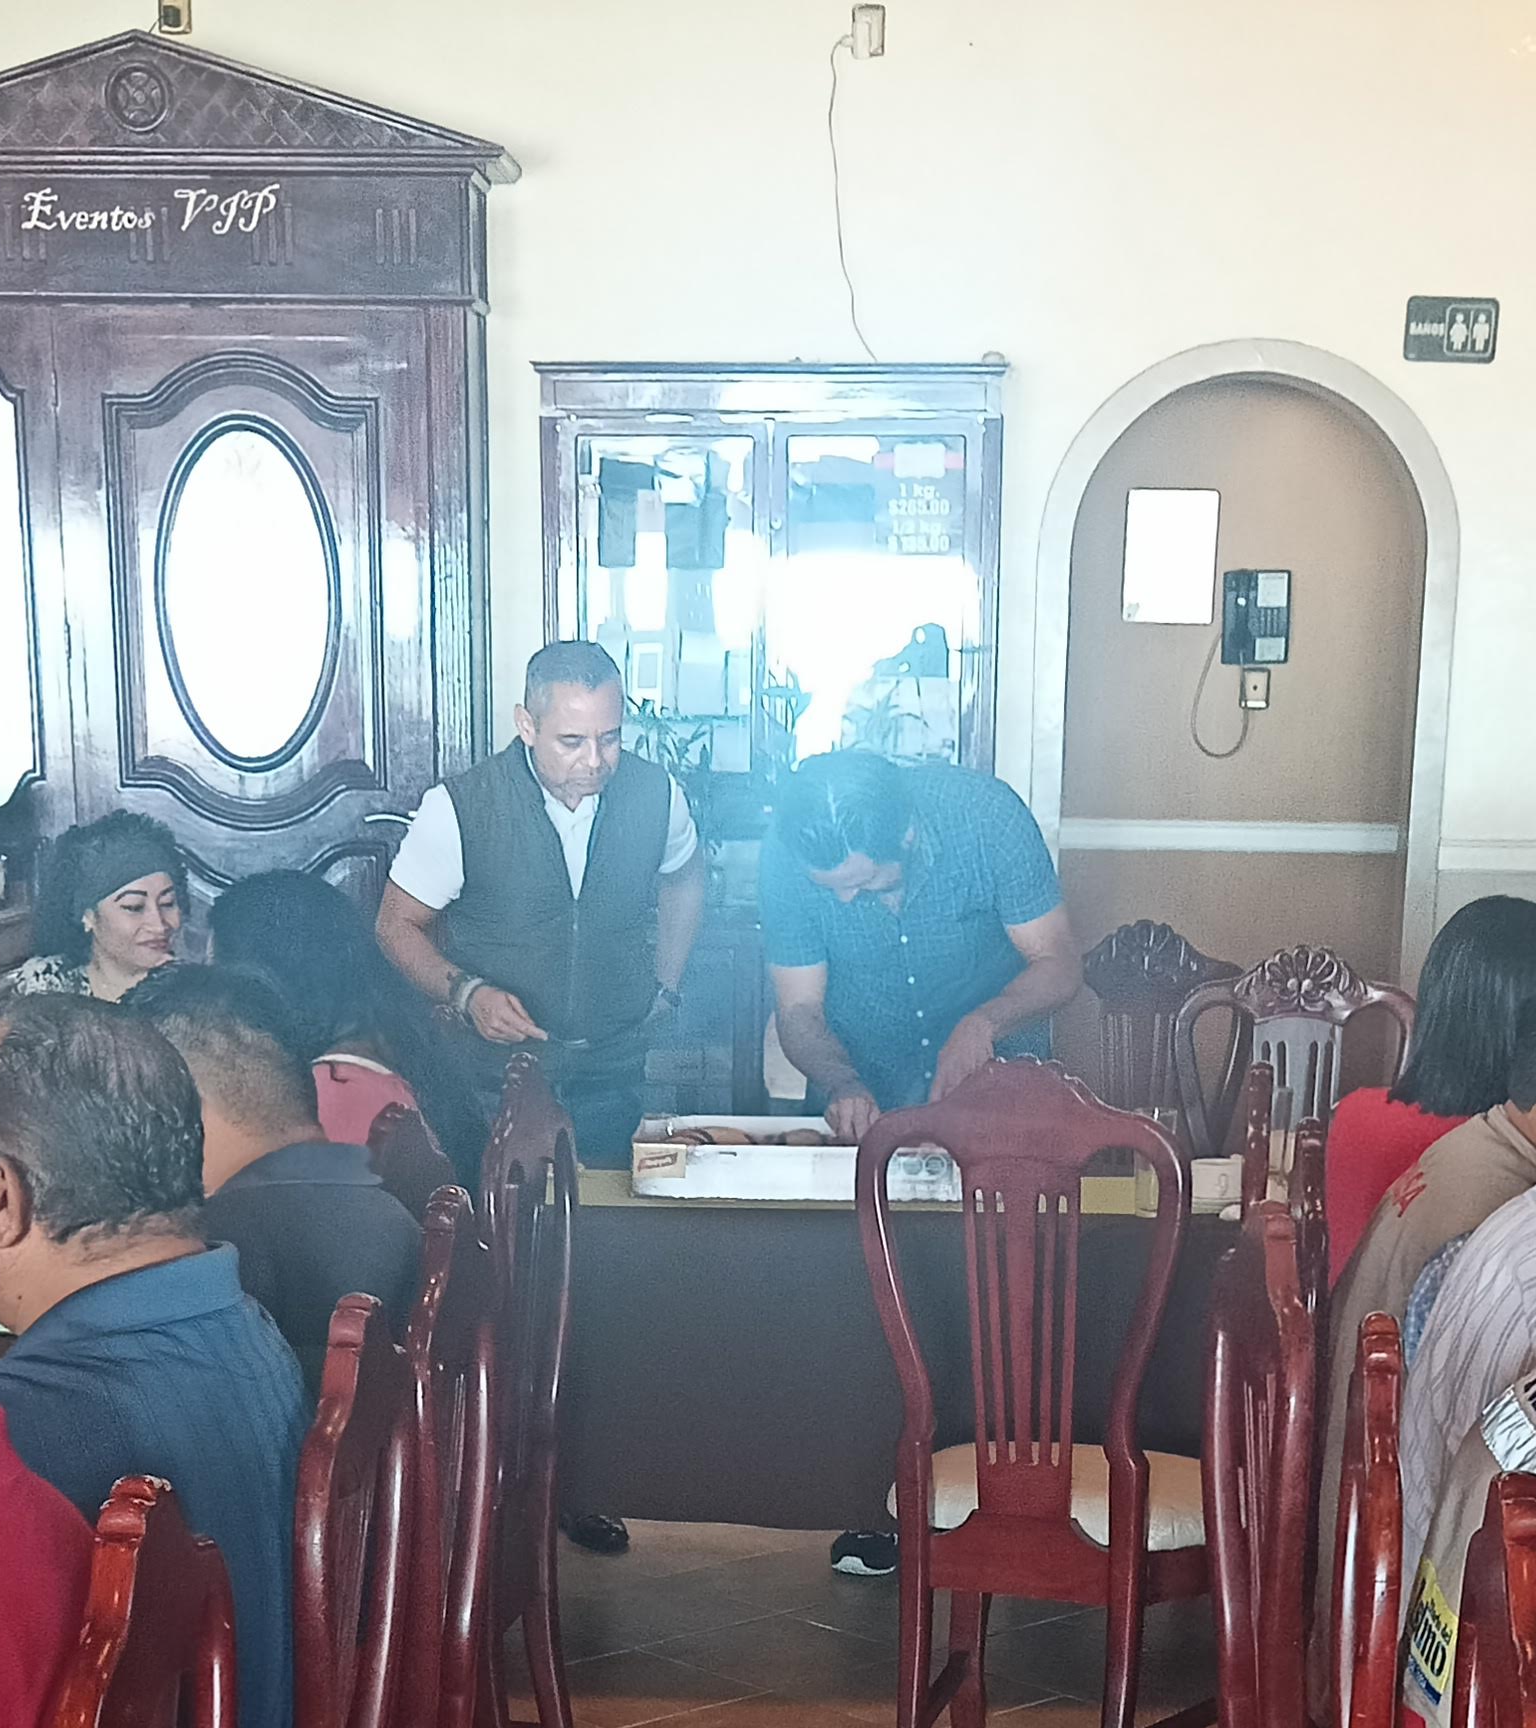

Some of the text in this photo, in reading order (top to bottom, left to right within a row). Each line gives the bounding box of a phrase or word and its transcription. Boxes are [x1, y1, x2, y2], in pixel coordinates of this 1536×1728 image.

[21, 184, 280, 234] Eventos VIP
[899, 482, 908, 497] 1
